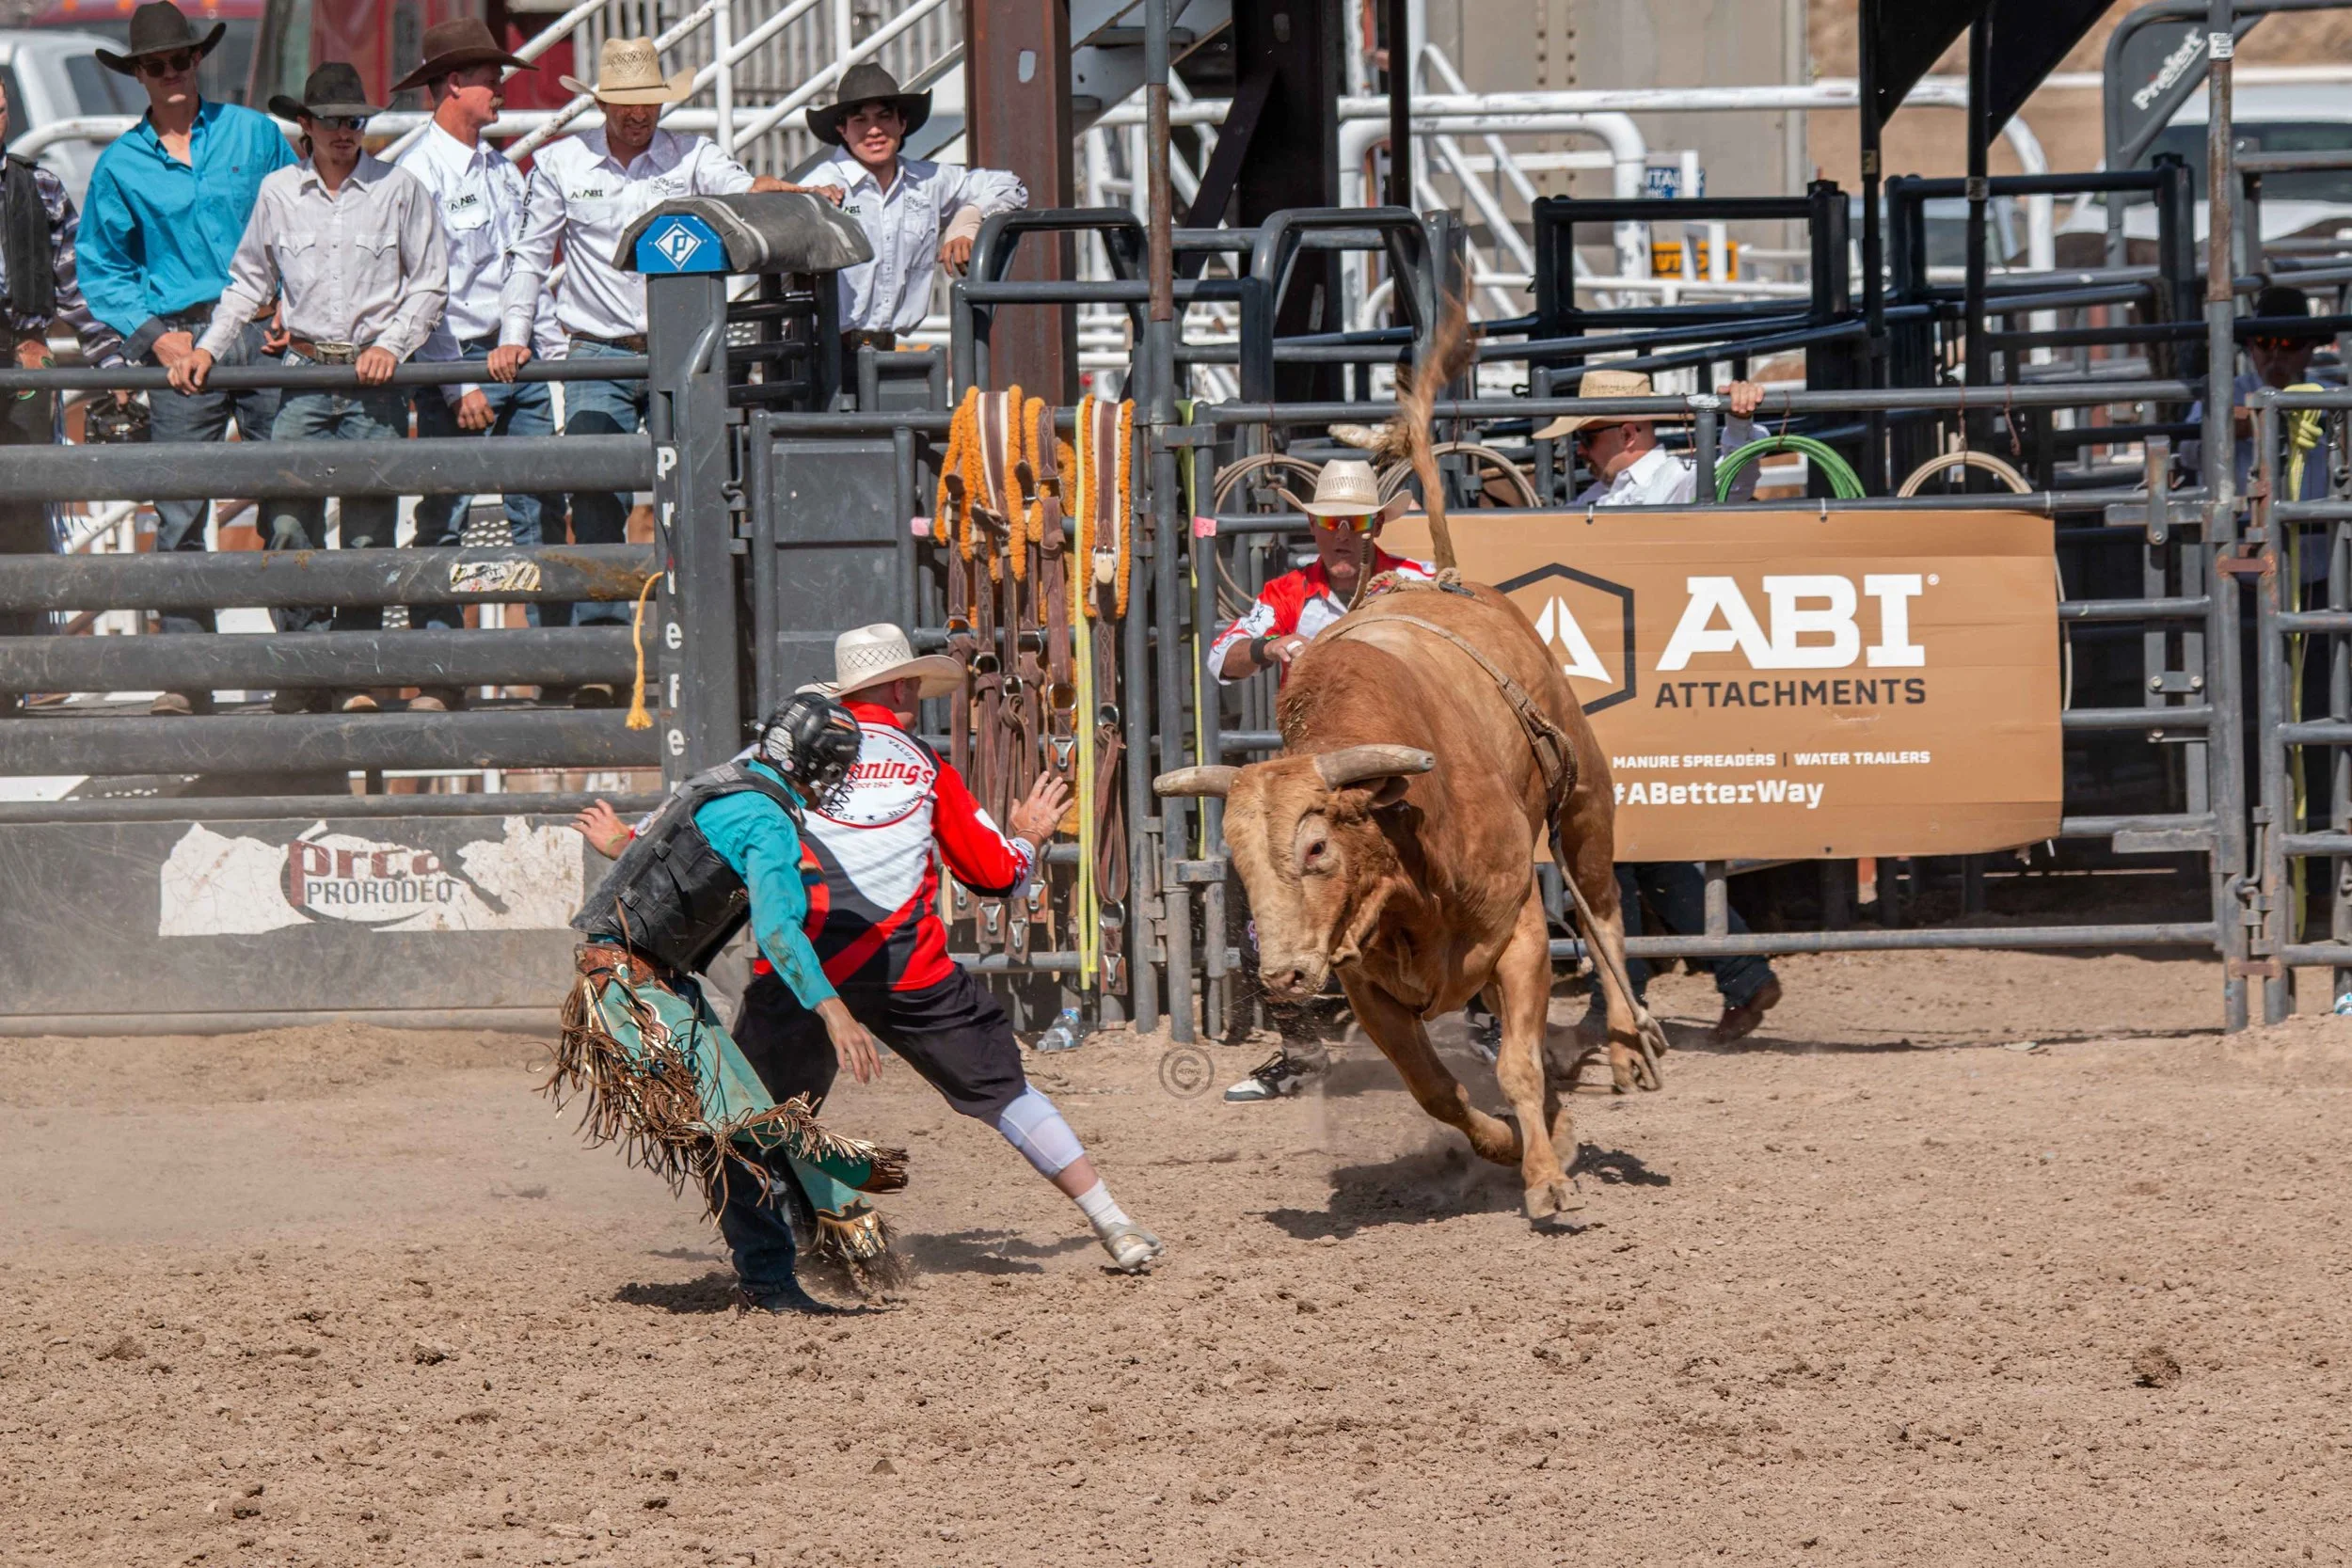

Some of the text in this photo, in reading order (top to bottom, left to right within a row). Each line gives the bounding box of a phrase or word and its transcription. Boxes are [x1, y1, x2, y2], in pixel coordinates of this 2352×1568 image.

[583, 189, 604, 198] ABI
[1654, 678, 1926, 708] ATTACHMENTS
[1613, 752, 1931, 768] MANURE SPREADERS WATER TRAILERS
[1613, 780, 1824, 809] #ABetterWay
[307, 880, 453, 906] PRORODEO
